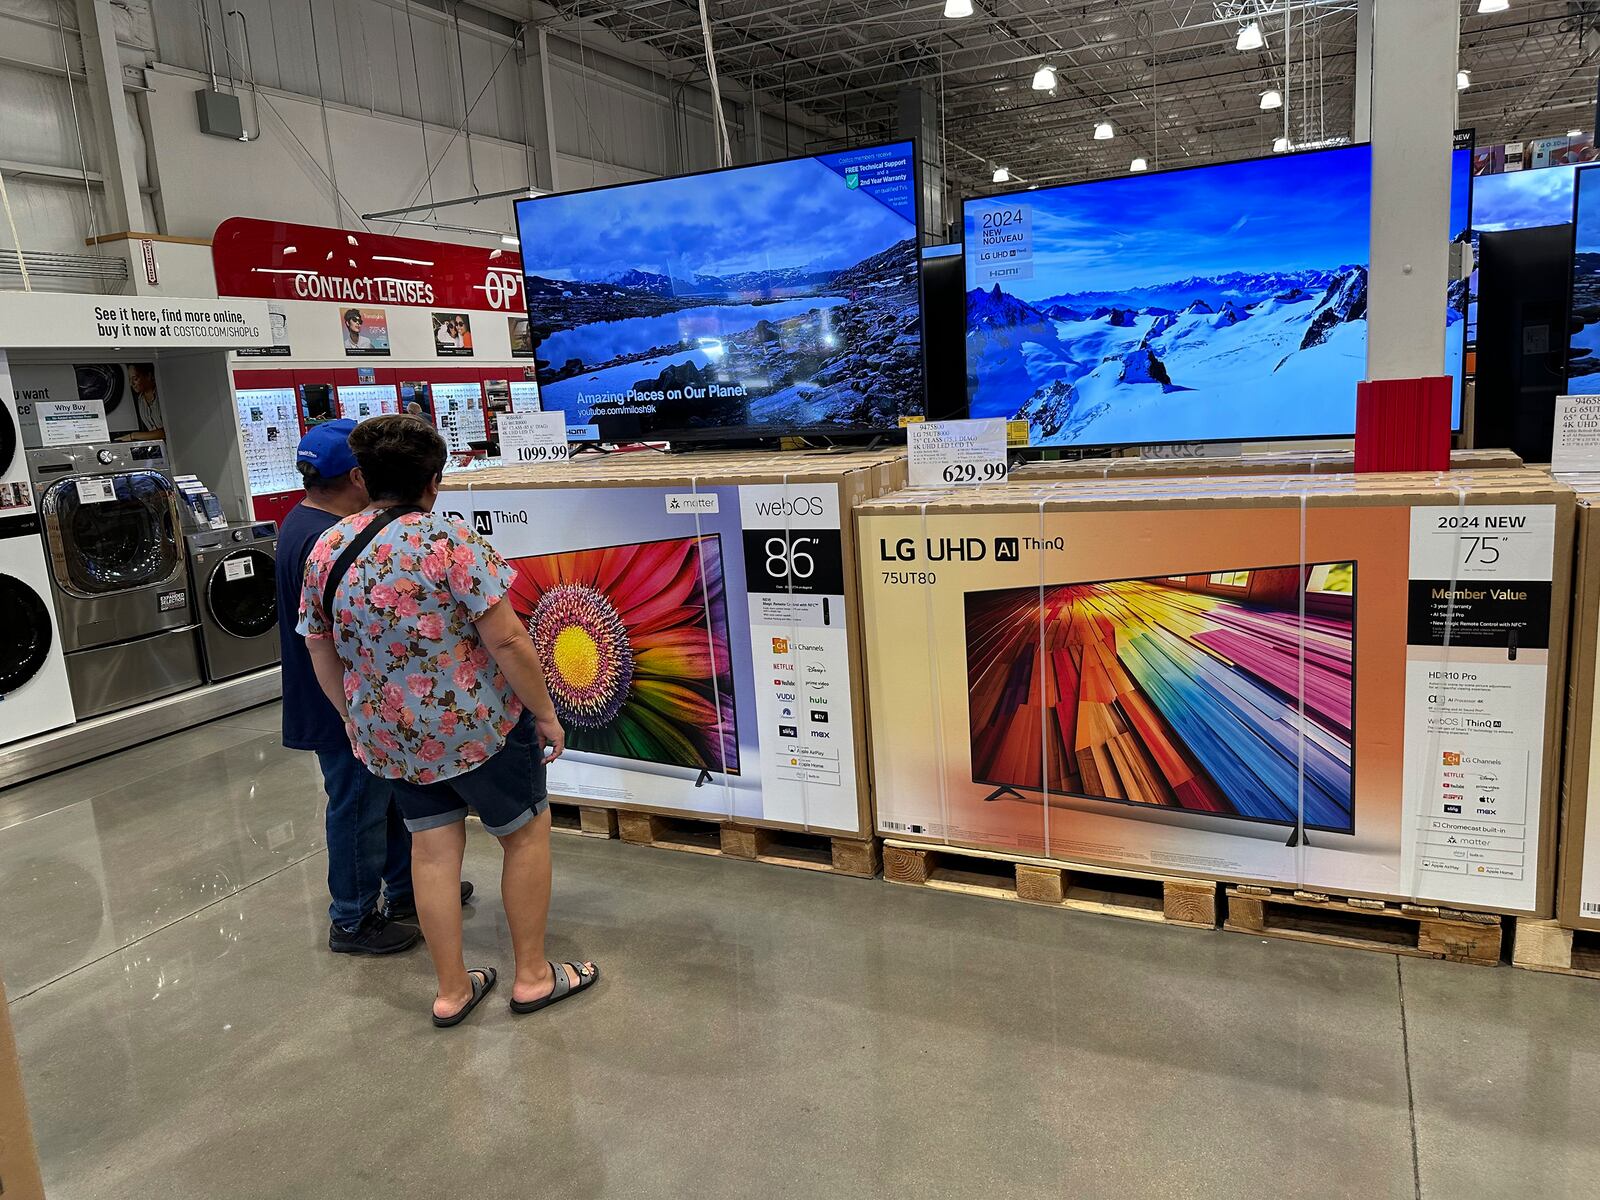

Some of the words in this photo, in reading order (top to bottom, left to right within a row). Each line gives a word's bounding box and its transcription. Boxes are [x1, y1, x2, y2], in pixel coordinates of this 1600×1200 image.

[845, 165, 859, 174] FREE
[860, 162, 883, 172] Technical
[884, 158, 906, 168] Support
[860, 178, 870, 186] 2nd
[883, 174, 907, 182] Warranty
[982, 208, 1023, 229] 2024
[982, 228, 1002, 238] NEW
[983, 233, 1024, 245] NOUVEAU
[980, 252, 991, 261] LG
[992, 250, 1009, 259] UHD
[294, 273, 374, 301] CONTACT
[377, 277, 435, 304] LENSES
[94, 306, 117, 322] See
[119, 306, 129, 321] it
[131, 307, 160, 323] here,
[161, 308, 182, 322] find
[184, 311, 211, 323] more
[213, 309, 246, 325] online,
[97, 323, 119, 339] buy
[121, 323, 132, 337] it
[133, 325, 157, 337] now
[159, 324, 172, 337] at
[173, 325, 260, 338] COSTCO.COM/SHOPLG
[22, 387, 50, 400] want
[576, 391, 625, 406] Amazing
[626, 388, 665, 403] Places
[666, 389, 682, 400] on
[683, 385, 707, 400] Our
[708, 382, 748, 398] Planet
[54, 404, 71, 413] Why
[72, 403, 87, 412] Buy
[577, 404, 657, 418] youtube.com/milosh9k
[1580, 413, 1600, 421] CLA
[1577, 420, 1598, 428] UHD
[517, 445, 568, 461] 1099.99
[942, 462, 1007, 483] 629.99
[755, 496, 824, 516] webOS
[475, 514, 491, 531] AI
[492, 510, 529, 525] ThinQ
[1437, 516, 1480, 529] 2024
[1484, 516, 1527, 528] NEW
[879, 537, 916, 562] LG
[926, 537, 987, 562] UHD
[996, 540, 1017, 559] AI
[1022, 536, 1065, 551] ThinQ
[1459, 536, 1509, 564] 75"
[764, 537, 820, 578] 86"
[881, 571, 937, 585] 75UT80
[1431, 587, 1487, 600] Member
[1489, 588, 1528, 601] Value
[797, 643, 824, 652] Channels
[772, 663, 794, 672] NETFLIX
[1461, 672, 1477, 681] Pro
[775, 692, 796, 701] VUDU
[809, 695, 829, 705] hulu
[1465, 719, 1493, 729] ThinQ
[810, 730, 831, 739] max
[1471, 757, 1502, 766] Channels
[1443, 771, 1465, 779] NETFLIX
[1441, 822, 1482, 832] Chromecast
[1482, 825, 1506, 834] built-in
[1460, 838, 1491, 847] matter
